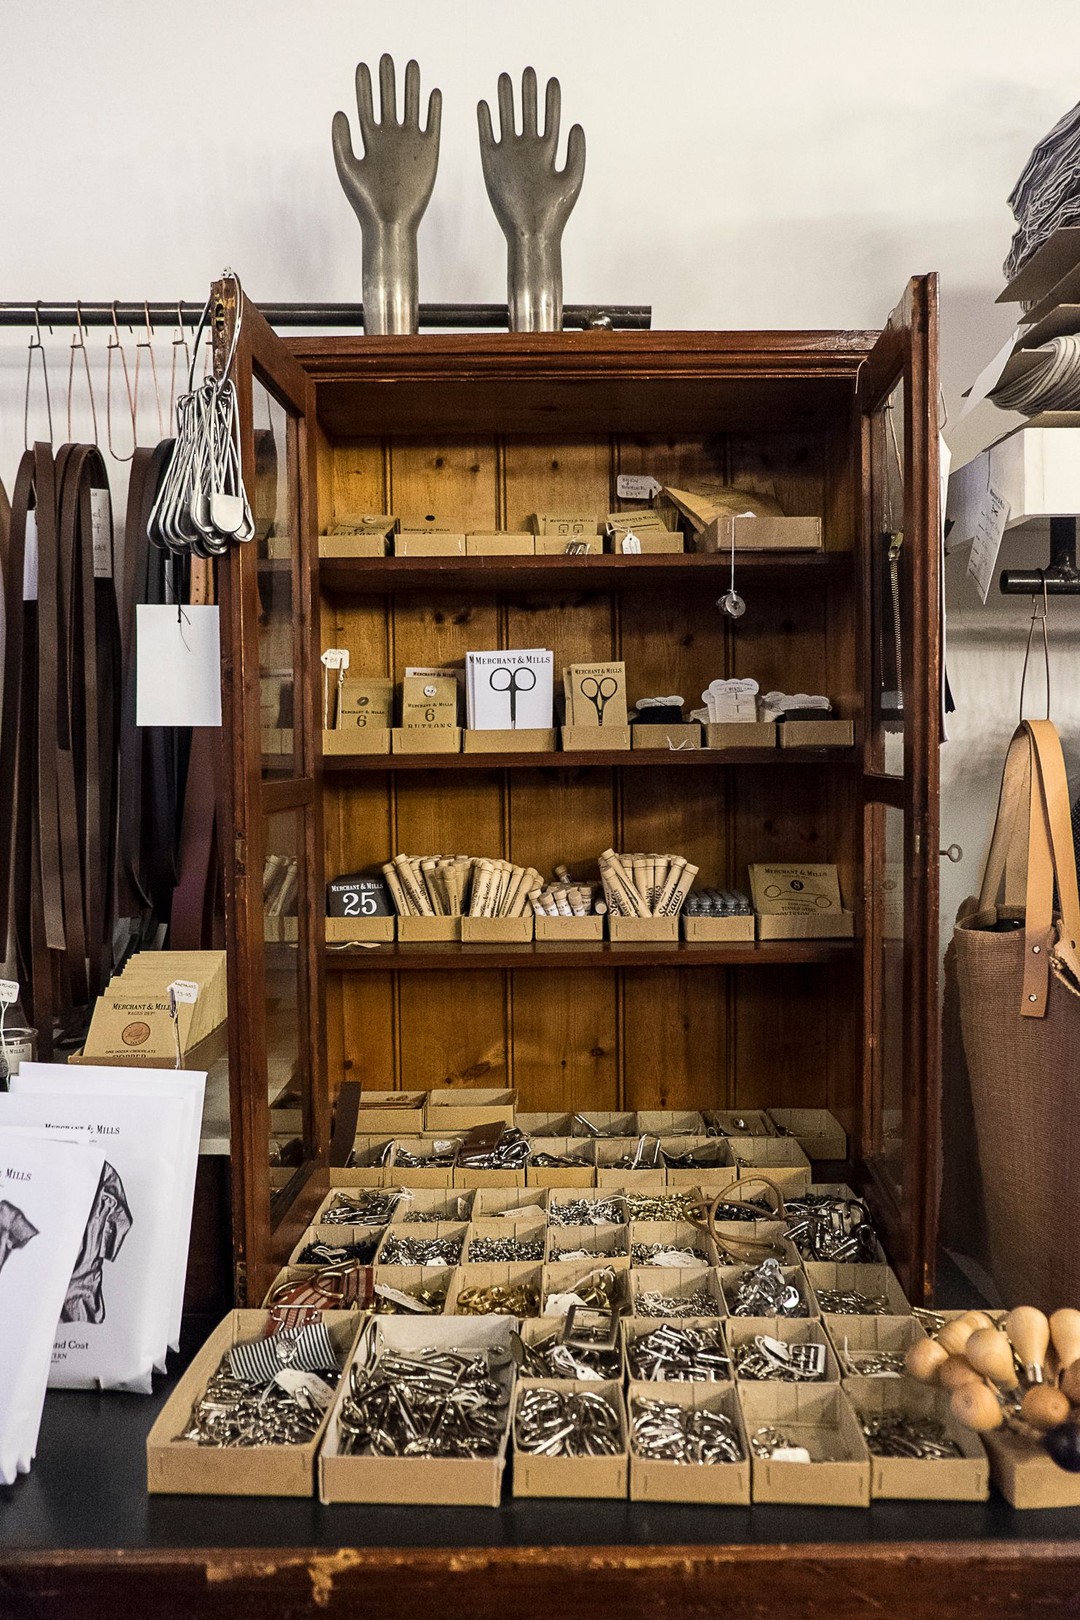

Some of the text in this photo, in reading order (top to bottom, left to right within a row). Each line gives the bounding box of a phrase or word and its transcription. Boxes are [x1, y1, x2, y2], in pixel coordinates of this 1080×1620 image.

[475, 656, 516, 665] MERCHANT
[518, 655, 525, 664] &
[526, 655, 551, 664] MILLS
[425, 708, 435, 722] 6
[357, 714, 367, 727] 6
[331, 884, 360, 892] MERCHANT
[343, 892, 377, 916] 25
[155, 1003, 171, 1011] MILL
[97, 1125, 120, 1135] MILLS
[6, 1168, 32, 1181] MILLS
[68, 1340, 89, 1349] Coat
